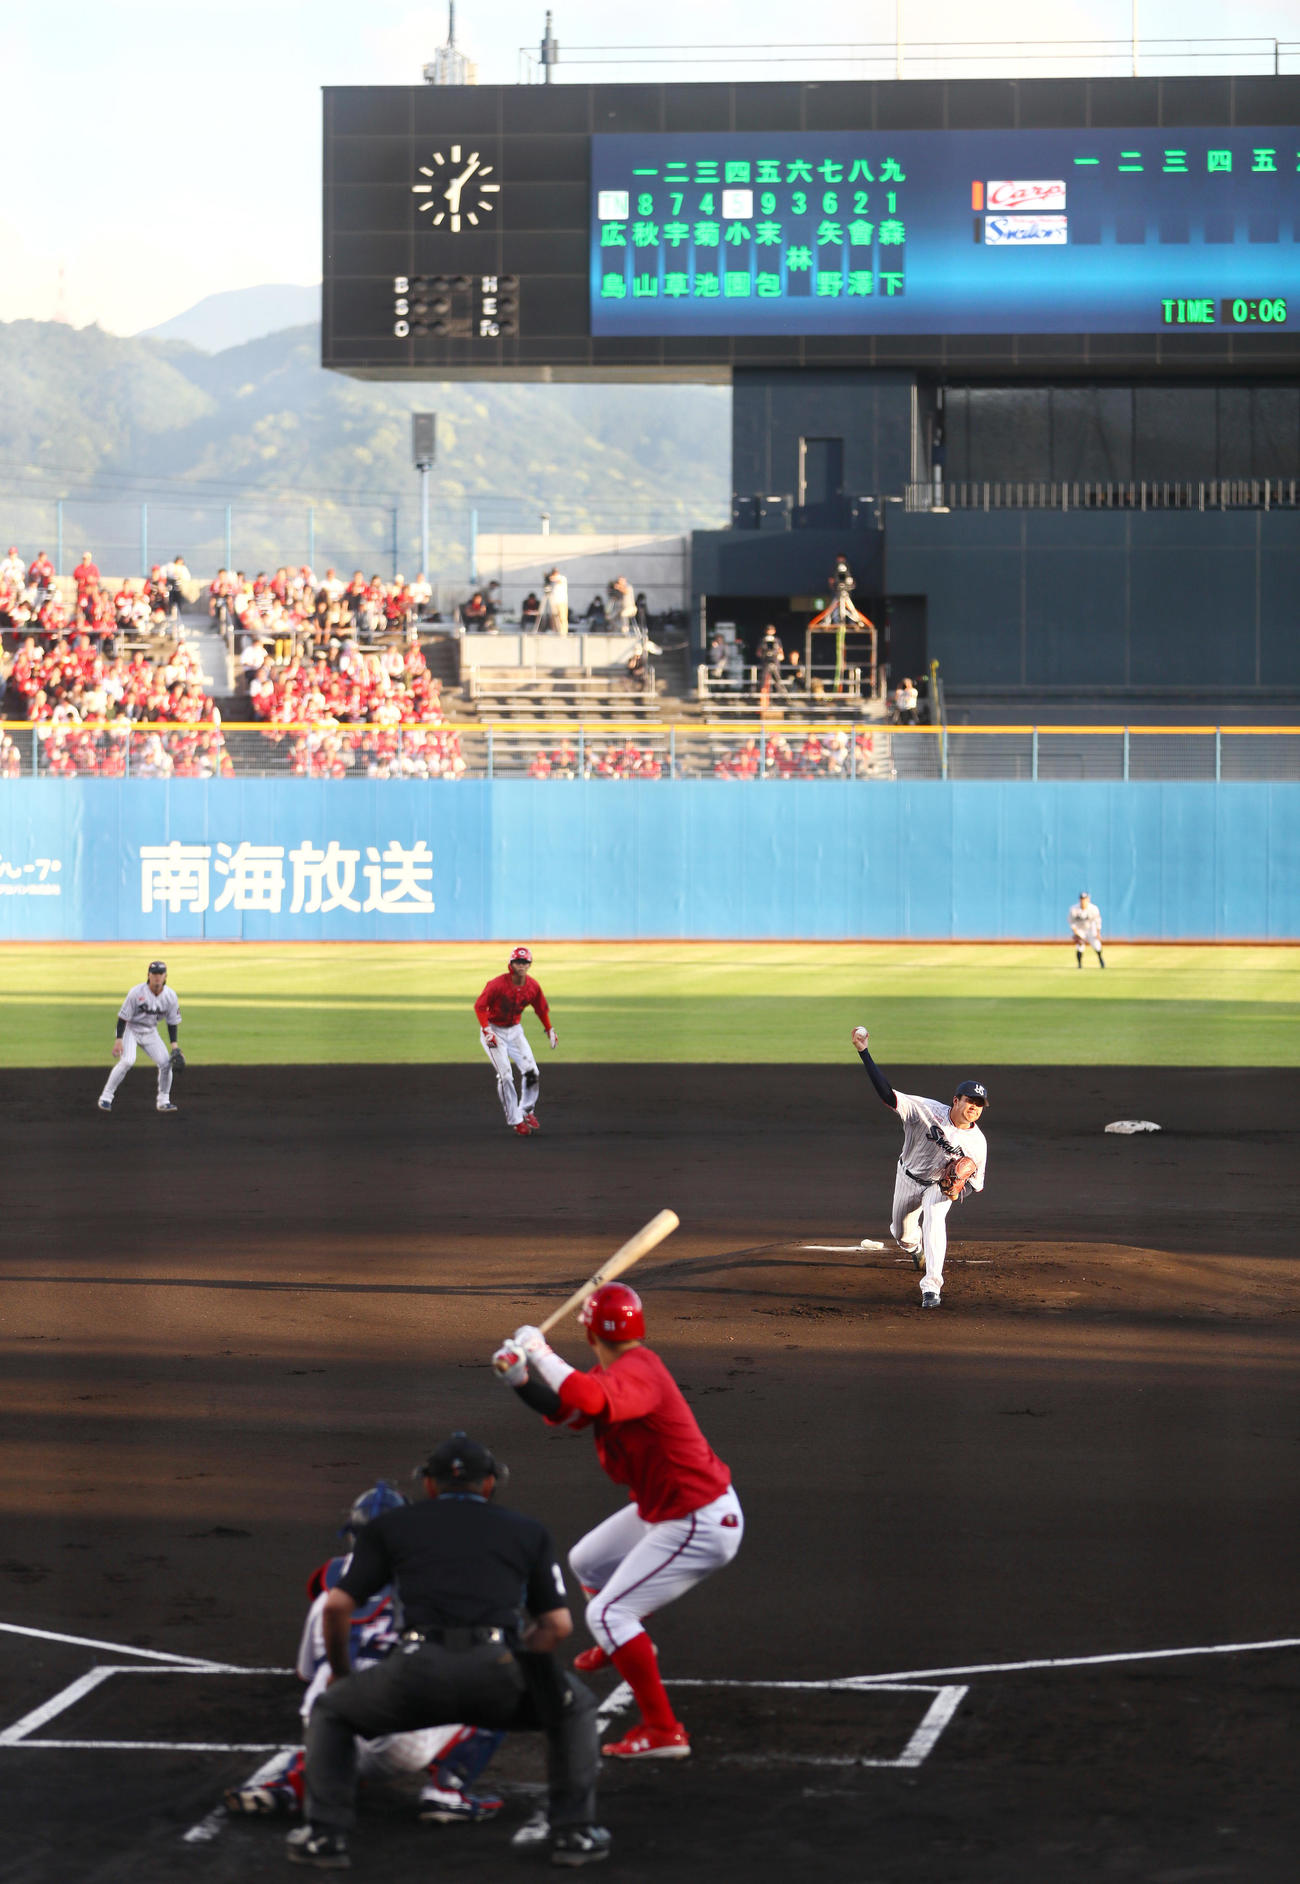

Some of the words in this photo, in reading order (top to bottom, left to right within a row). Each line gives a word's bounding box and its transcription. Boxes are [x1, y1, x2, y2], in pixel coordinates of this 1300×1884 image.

[1118, 152, 1144, 172] 二
[1163, 150, 1188, 172] 三
[1208, 150, 1233, 172] 四
[1252, 148, 1277, 172] 五
[638, 193, 653, 216] 8
[670, 192, 684, 215] 7
[699, 192, 714, 214] 4
[761, 192, 776, 214] 9
[792, 192, 807, 214] 3
[823, 191, 837, 214] 6
[854, 191, 868, 214] 2
[887, 192, 896, 213] 1
[395, 277, 409, 293] B
[482, 276, 498, 293] H
[395, 299, 409, 315] S
[483, 298, 497, 315] E
[1162, 299, 1214, 323] TIME
[1232, 298, 1286, 323] 0:06
[395, 321, 409, 337] O
[140, 841, 435, 913] 南海放送
